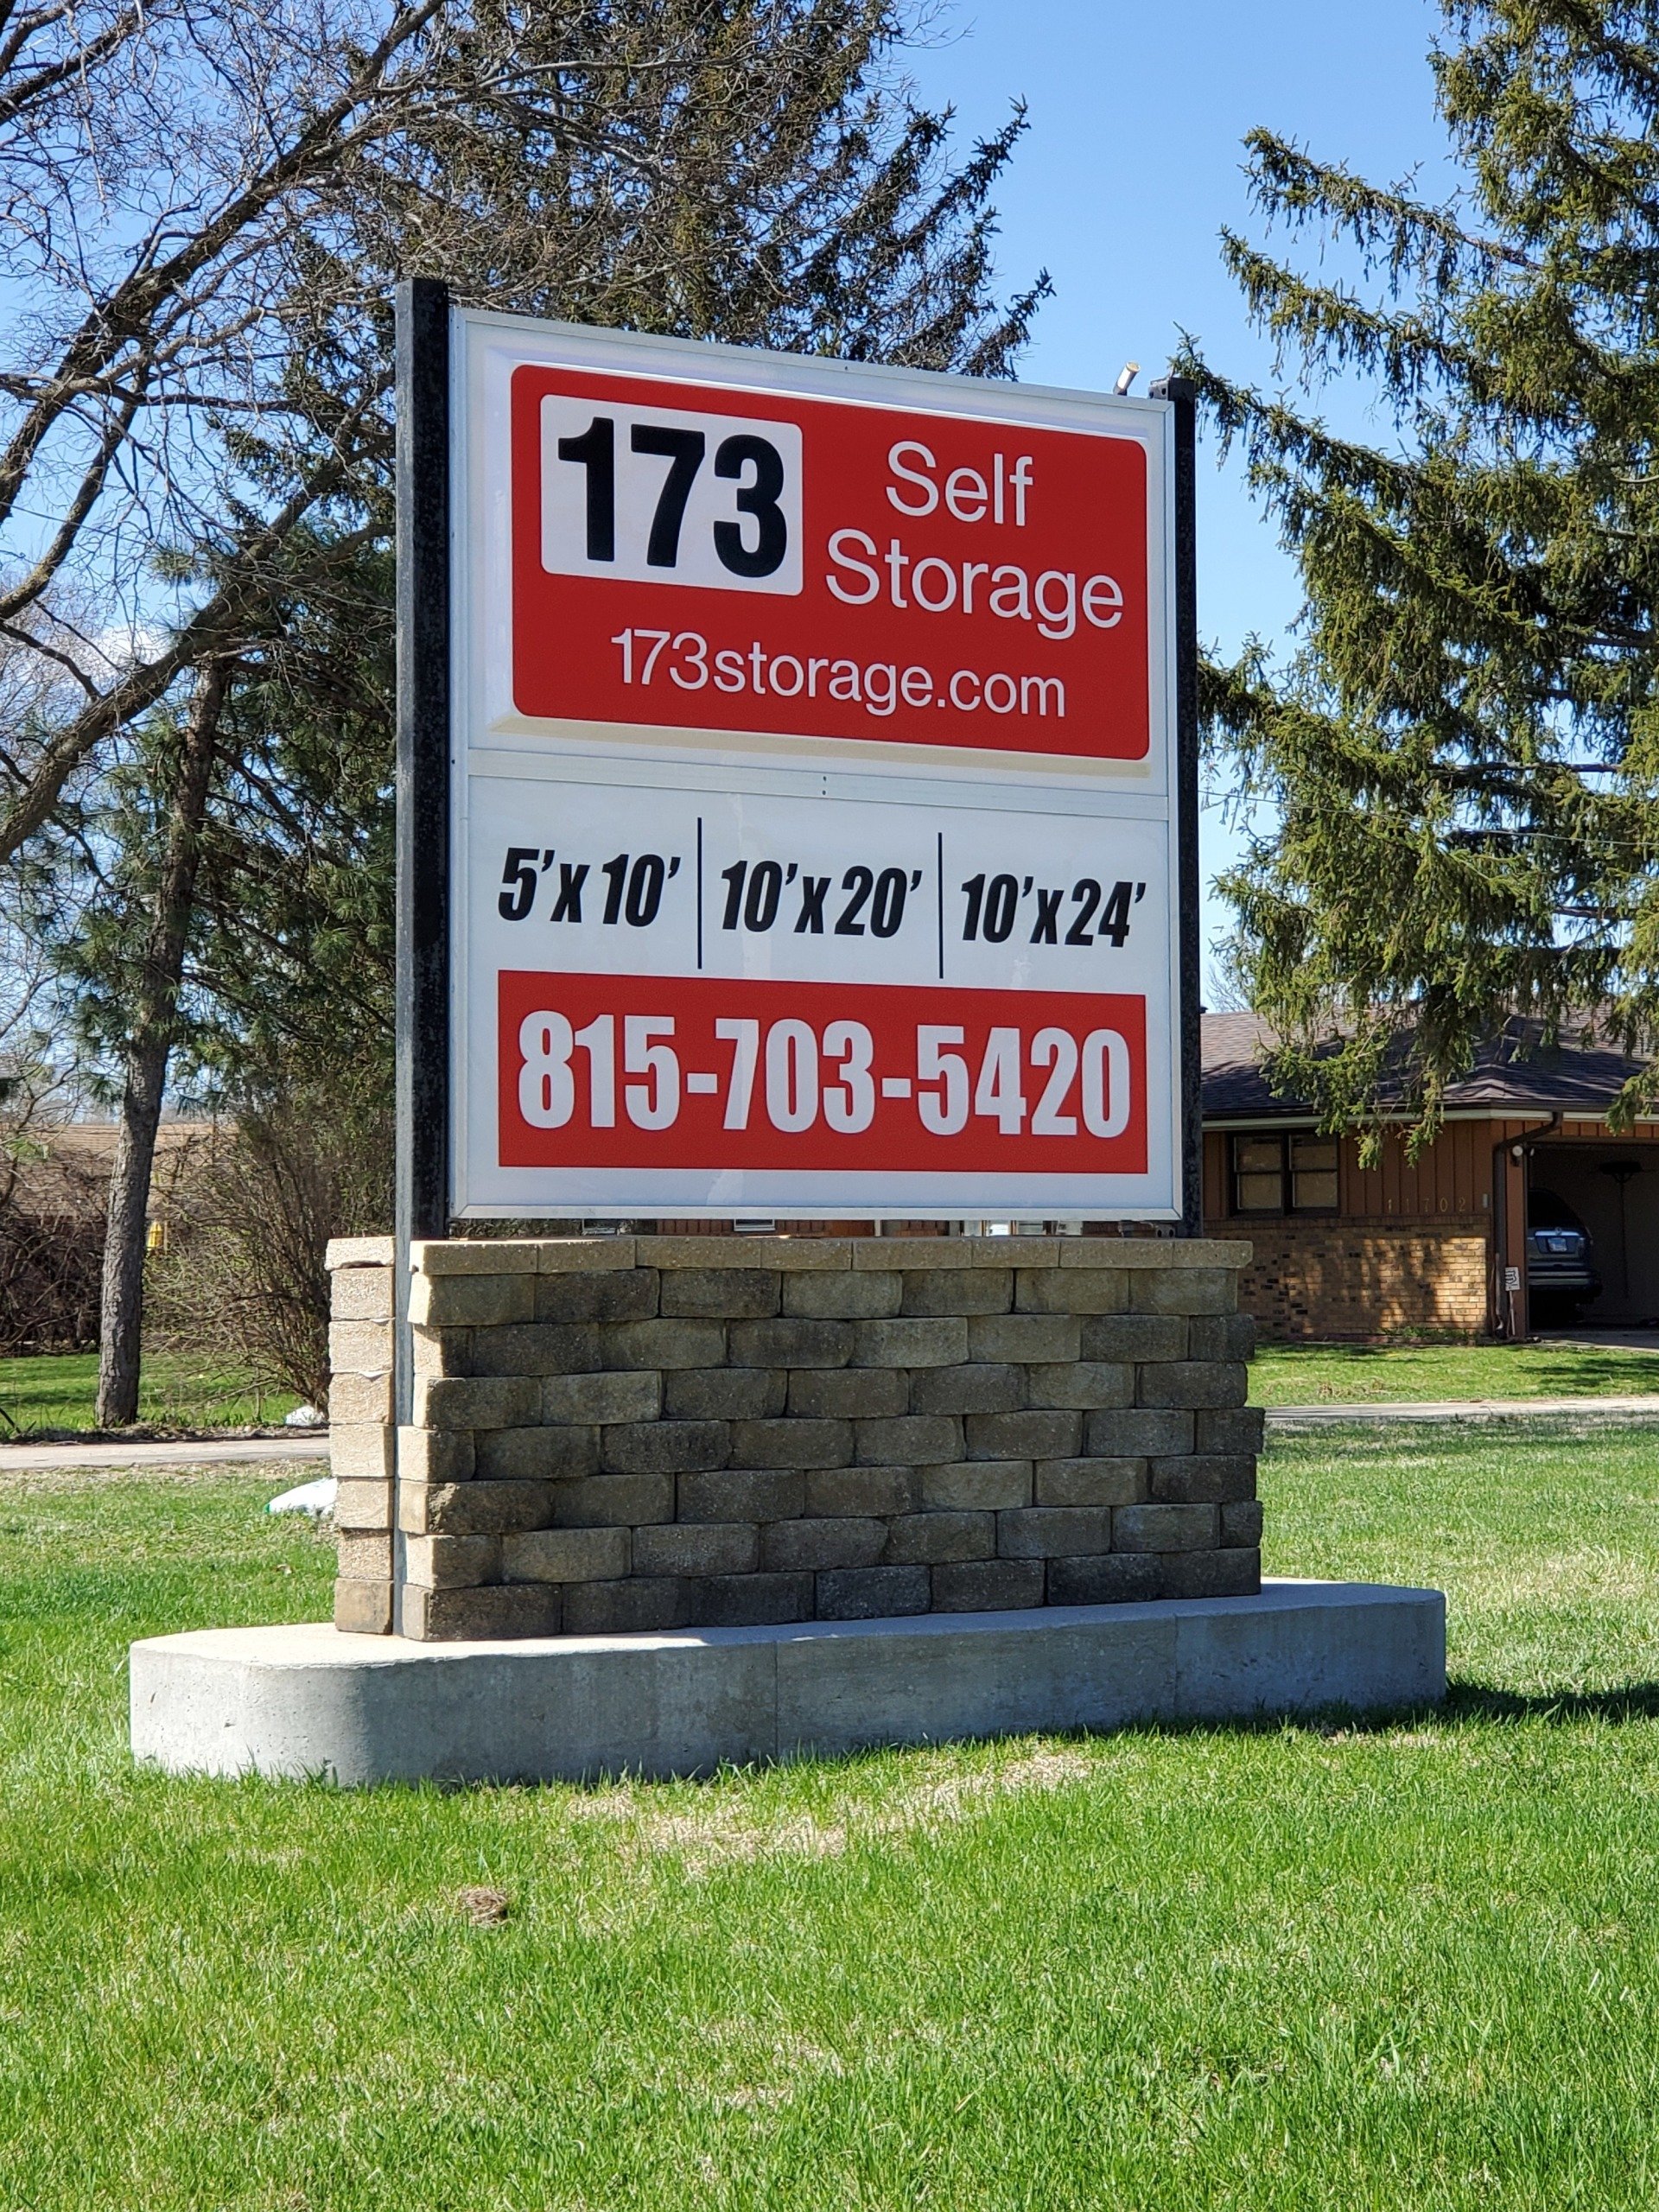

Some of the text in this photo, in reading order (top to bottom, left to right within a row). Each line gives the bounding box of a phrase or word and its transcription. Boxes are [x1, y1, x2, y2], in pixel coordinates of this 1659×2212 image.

[557, 416, 787, 578] 173
[886, 441, 1034, 527] Self
[825, 528, 1124, 639] Storage
[611, 627, 1065, 717] 173storage.com
[518, 1010, 1131, 1139] 815-703-5420
